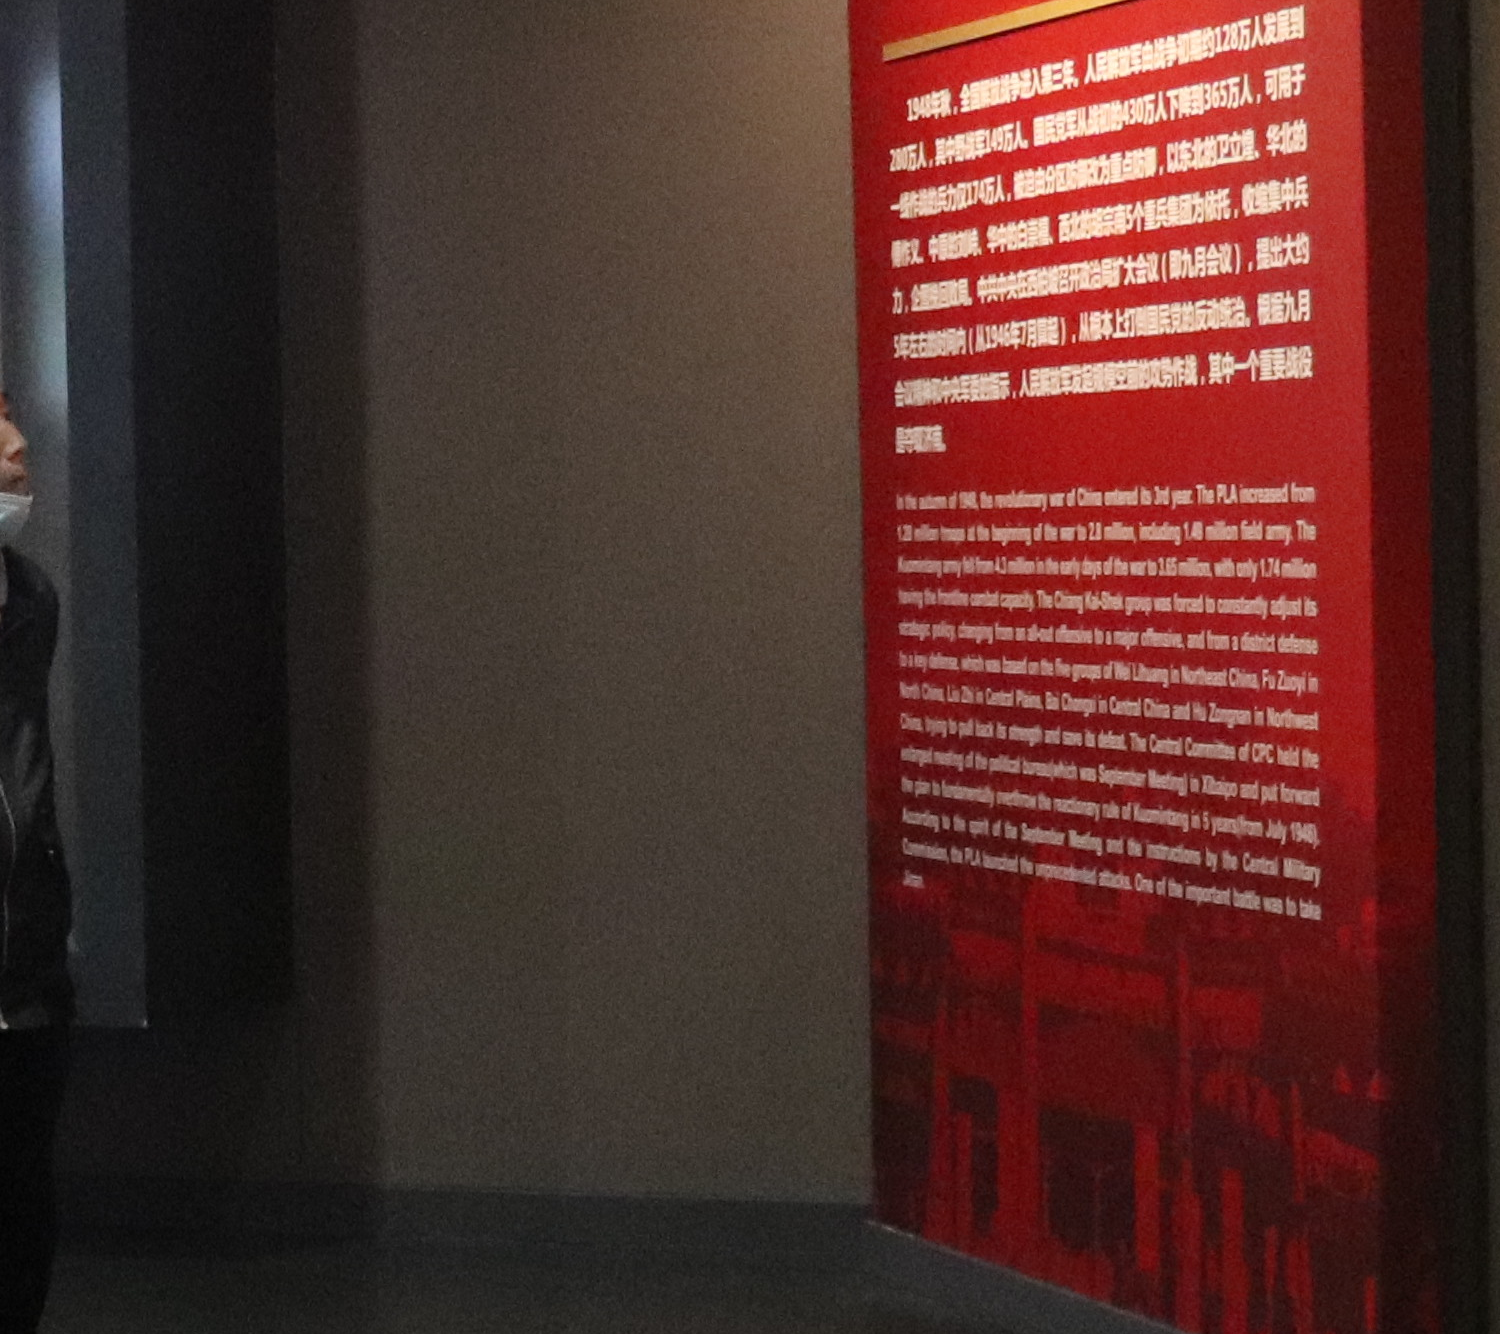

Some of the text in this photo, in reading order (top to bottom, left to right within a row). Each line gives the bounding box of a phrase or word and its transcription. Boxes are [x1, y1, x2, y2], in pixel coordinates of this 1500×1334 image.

[1195, 484, 1214, 505] The
[1216, 484, 1237, 505] PLA
[1290, 482, 1316, 503] from
[1295, 519, 1317, 541] The
